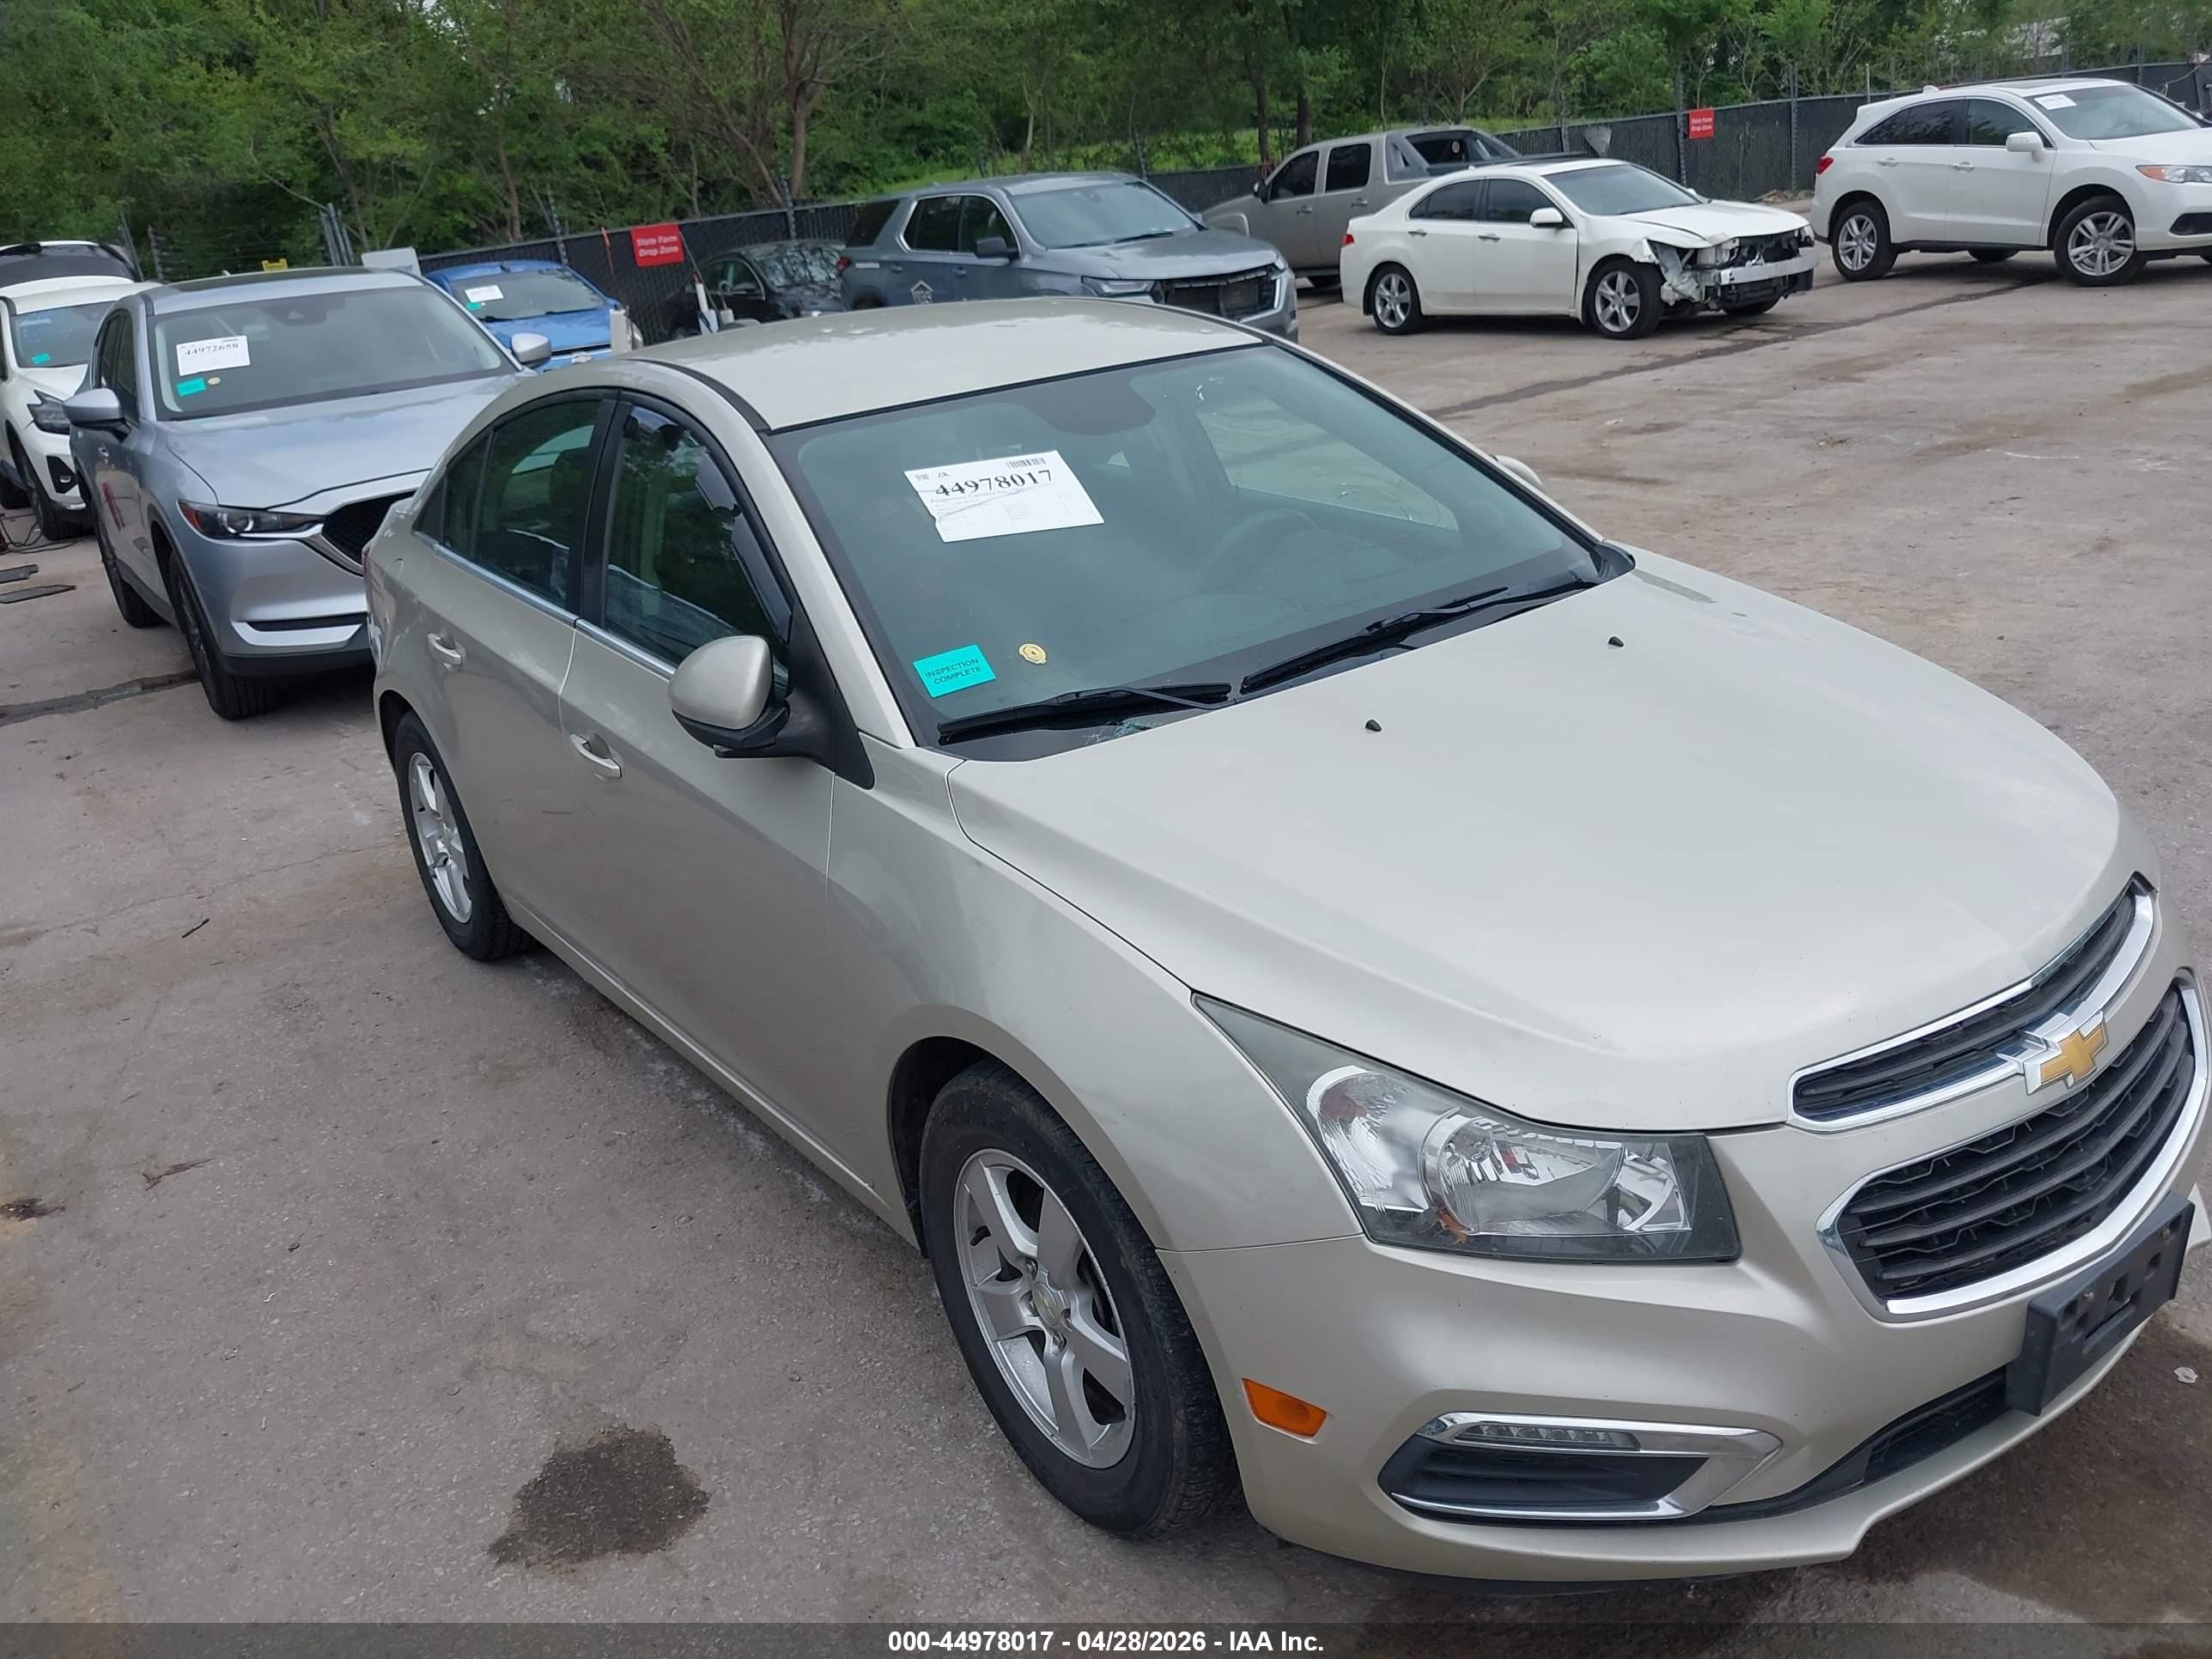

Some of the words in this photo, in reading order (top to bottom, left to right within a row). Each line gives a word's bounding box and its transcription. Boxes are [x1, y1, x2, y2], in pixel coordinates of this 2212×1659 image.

[638, 247, 659, 258] Drop
[659, 245, 679, 255] Zone
[935, 469, 1052, 496] 44978017
[924, 658, 980, 678] INSPECTION
[933, 665, 983, 685] COMPLETE
